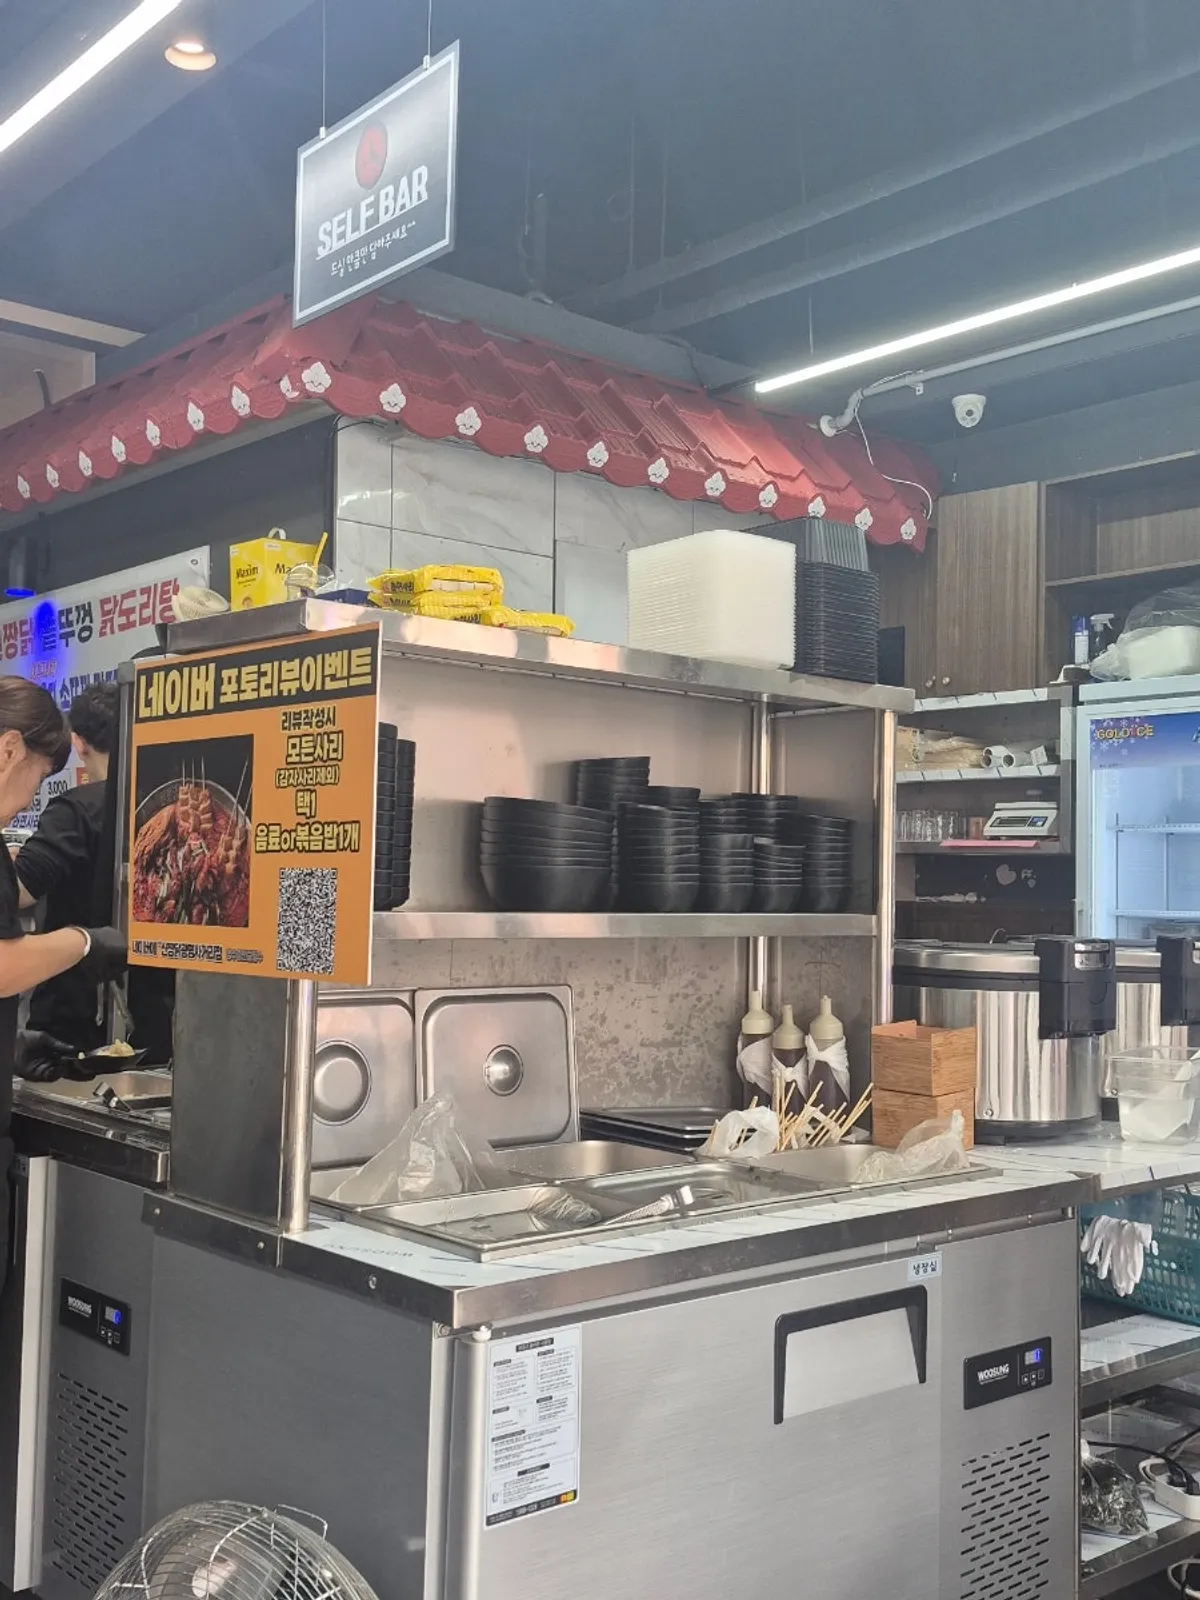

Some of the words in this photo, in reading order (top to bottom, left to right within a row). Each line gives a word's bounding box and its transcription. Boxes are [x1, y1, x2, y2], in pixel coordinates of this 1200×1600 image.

[318, 195, 375, 255] SELF
[378, 165, 428, 224] BAR
[98, 577, 181, 639] 닭도리탕
[138, 662, 216, 719] 네이버
[219, 646, 373, 704] 포토리뷰이벤트
[281, 705, 337, 732] 리뷰작성시
[286, 730, 344, 765] 모든사리
[275, 765, 340, 789] (감자사리제외)
[295, 788, 317, 819] 택1
[912, 1260, 938, 1276] 냉장실
[977, 1363, 1010, 1383] WOOSUNG
